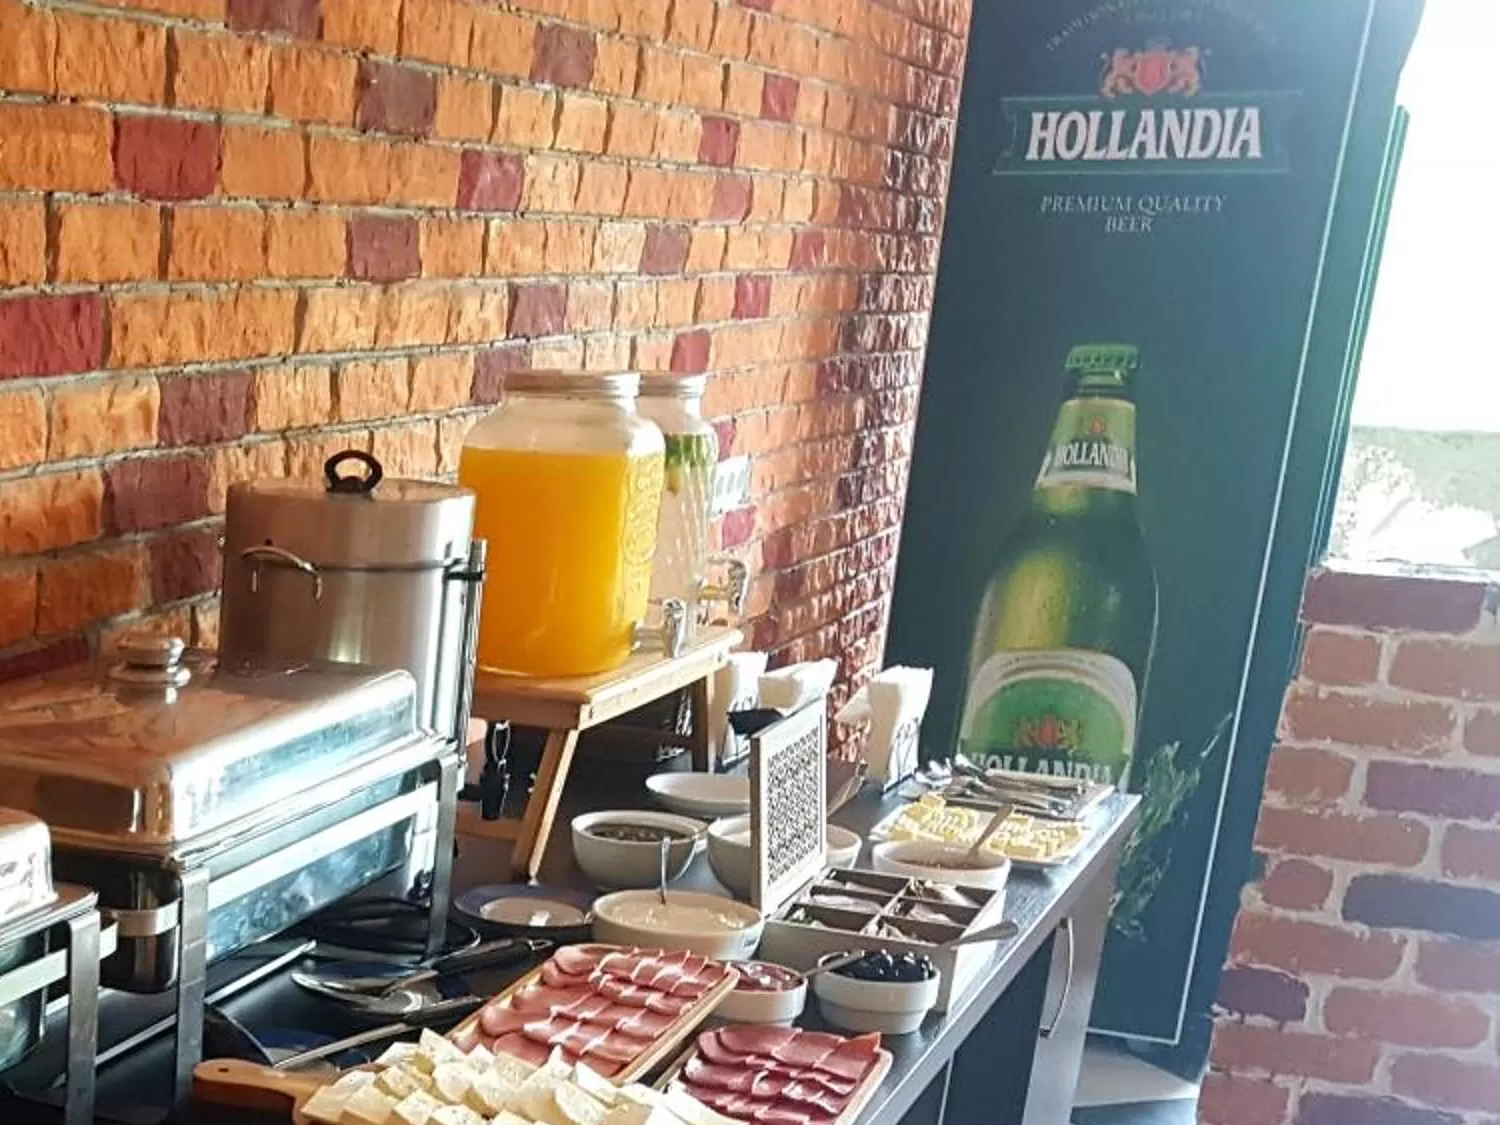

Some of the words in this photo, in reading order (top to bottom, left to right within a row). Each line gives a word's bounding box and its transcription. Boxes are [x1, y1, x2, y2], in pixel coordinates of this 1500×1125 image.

[1025, 107, 1263, 161] HOLLANDIA
[1039, 195, 1133, 214] PREMIUM
[1137, 194, 1227, 215] QUALITY
[1104, 216, 1153, 233] BEER
